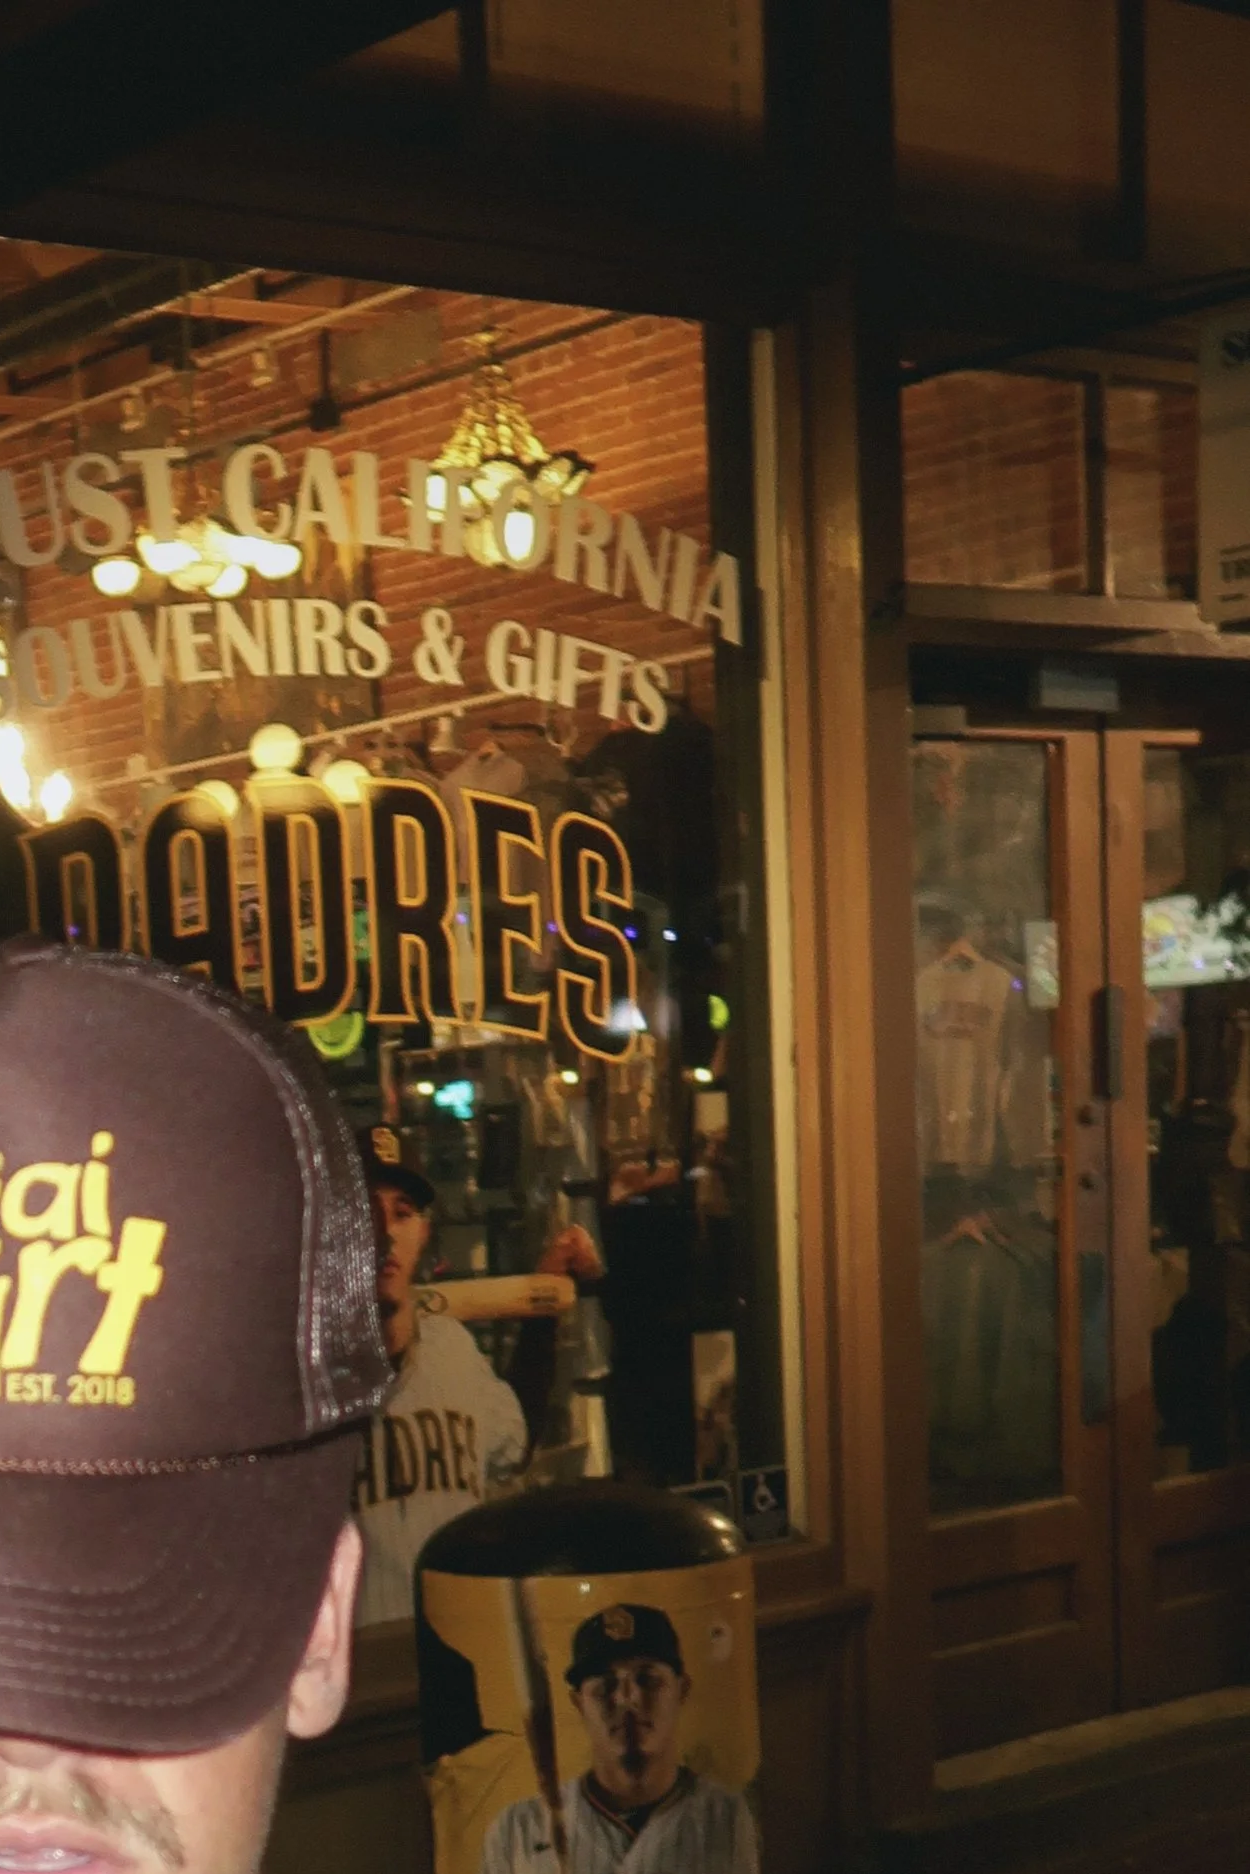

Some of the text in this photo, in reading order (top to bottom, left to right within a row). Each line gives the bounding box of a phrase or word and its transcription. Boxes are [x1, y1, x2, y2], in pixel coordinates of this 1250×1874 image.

[224, 443, 745, 645] CALIFORNIA
[412, 606, 466, 688] &
[486, 618, 670, 736] GIFTS
[4, 1373, 137, 1406] EST. 2018
